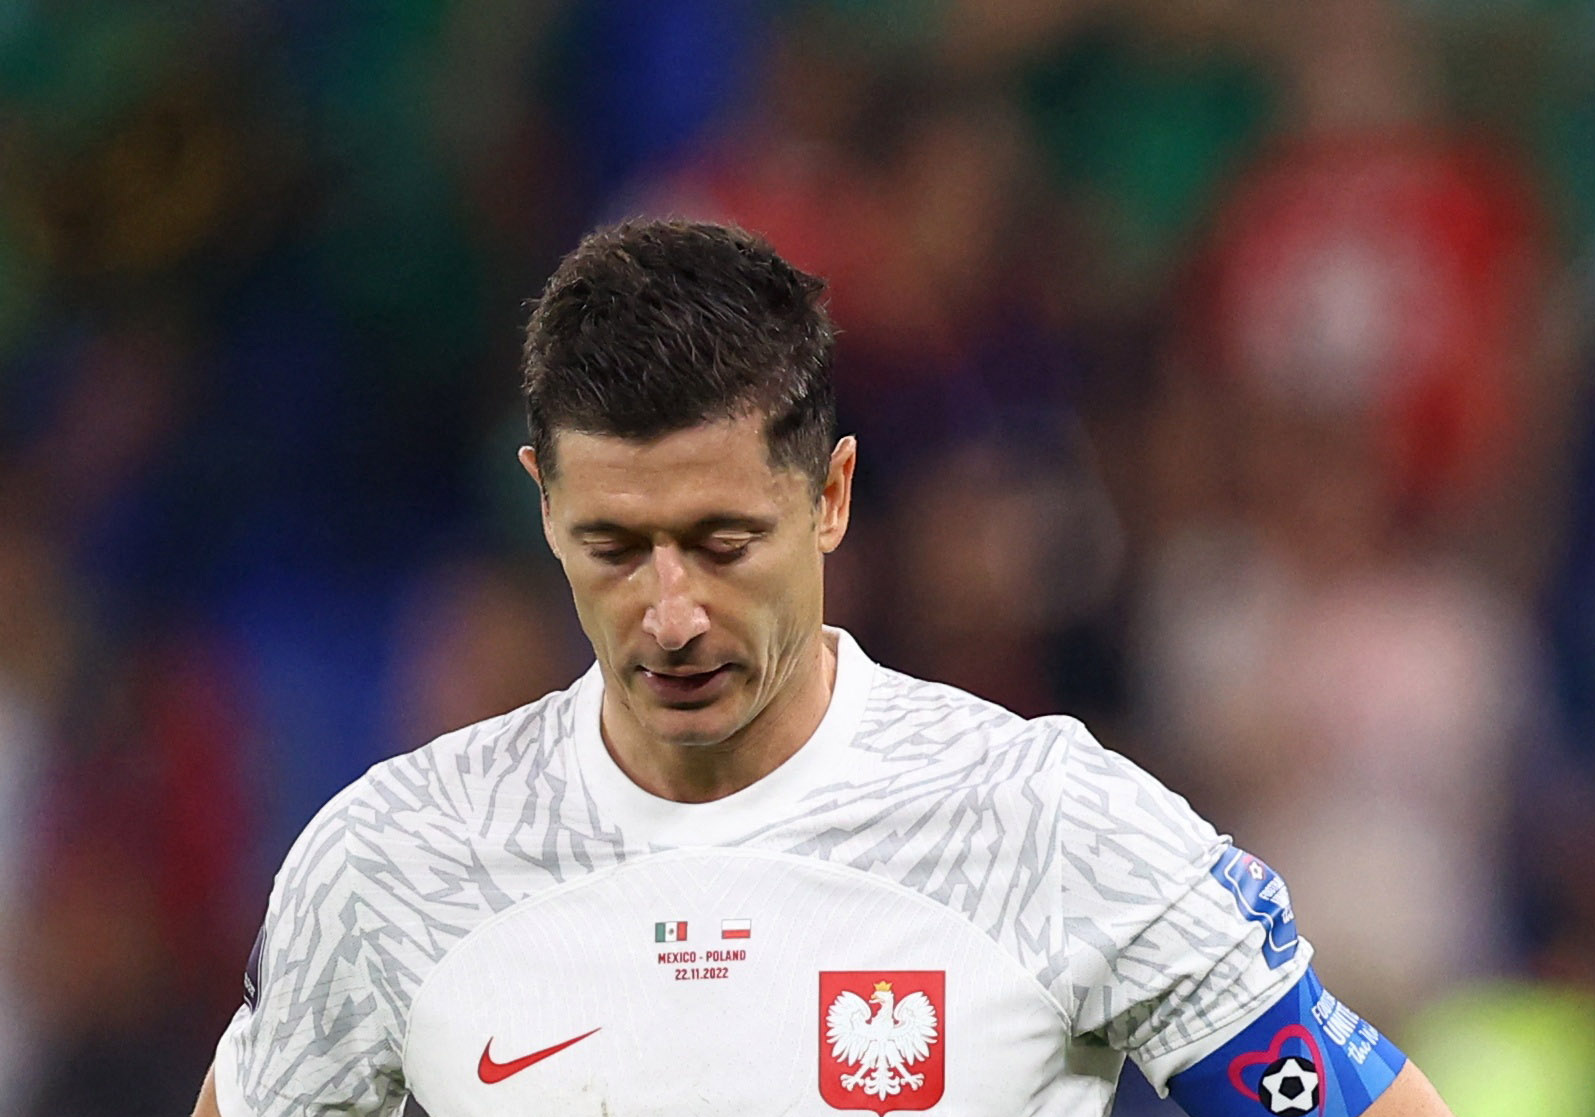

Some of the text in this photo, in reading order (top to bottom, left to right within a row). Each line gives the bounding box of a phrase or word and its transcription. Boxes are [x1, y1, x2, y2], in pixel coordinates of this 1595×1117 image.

[658, 952, 696, 964] MEXICO
[706, 950, 746, 962] POLAND
[675, 967, 728, 980] 22.11.2022
